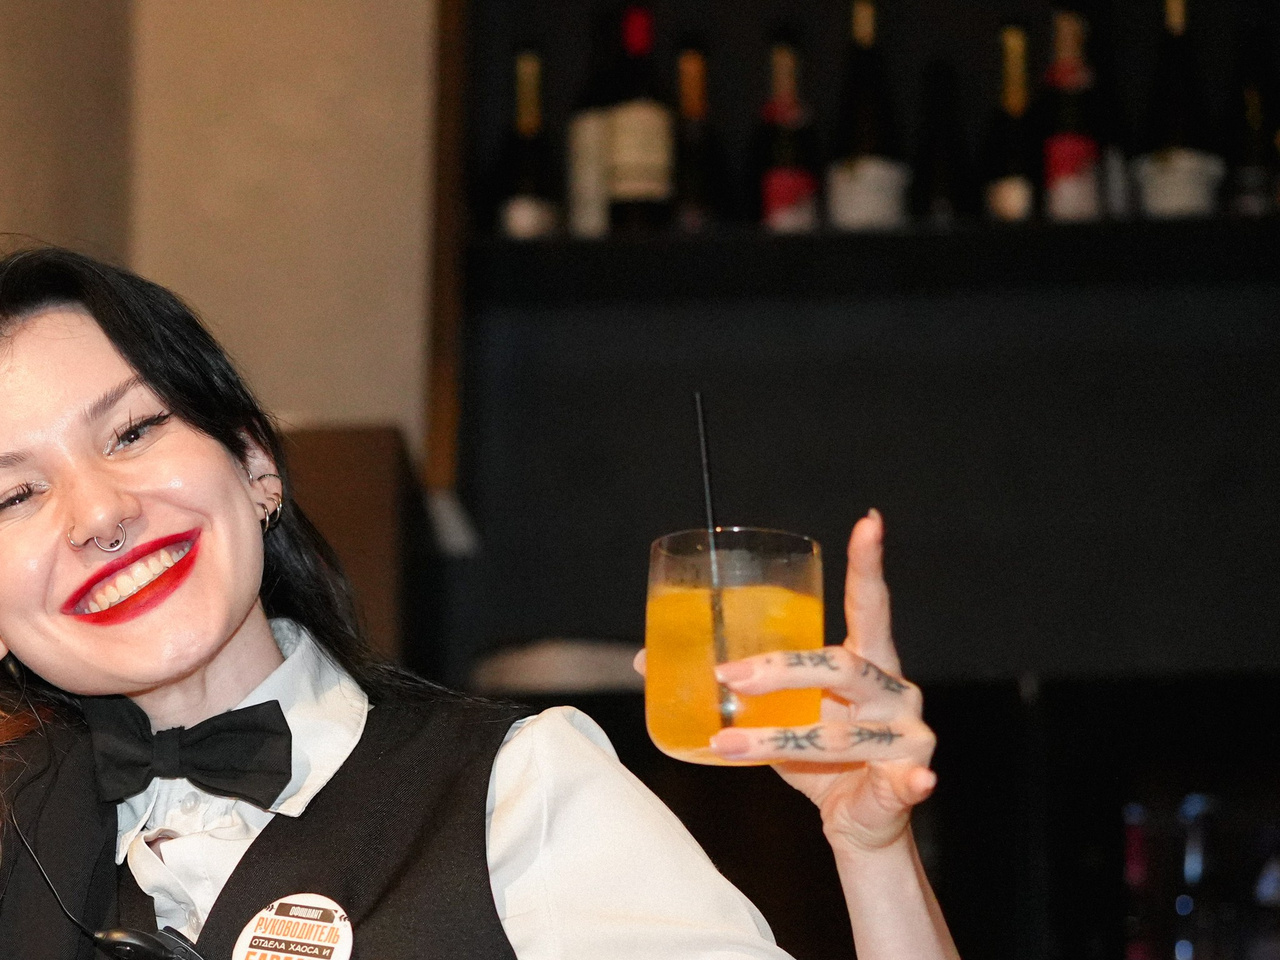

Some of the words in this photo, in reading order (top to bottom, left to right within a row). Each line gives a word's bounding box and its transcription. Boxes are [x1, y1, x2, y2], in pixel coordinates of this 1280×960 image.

[253, 916, 341, 945] РУКОВОДИТЕЛЬ
[252, 938, 286, 950] ОТДЕЛА
[289, 943, 319, 955] ХАОСА
[322, 949, 331, 957] И
